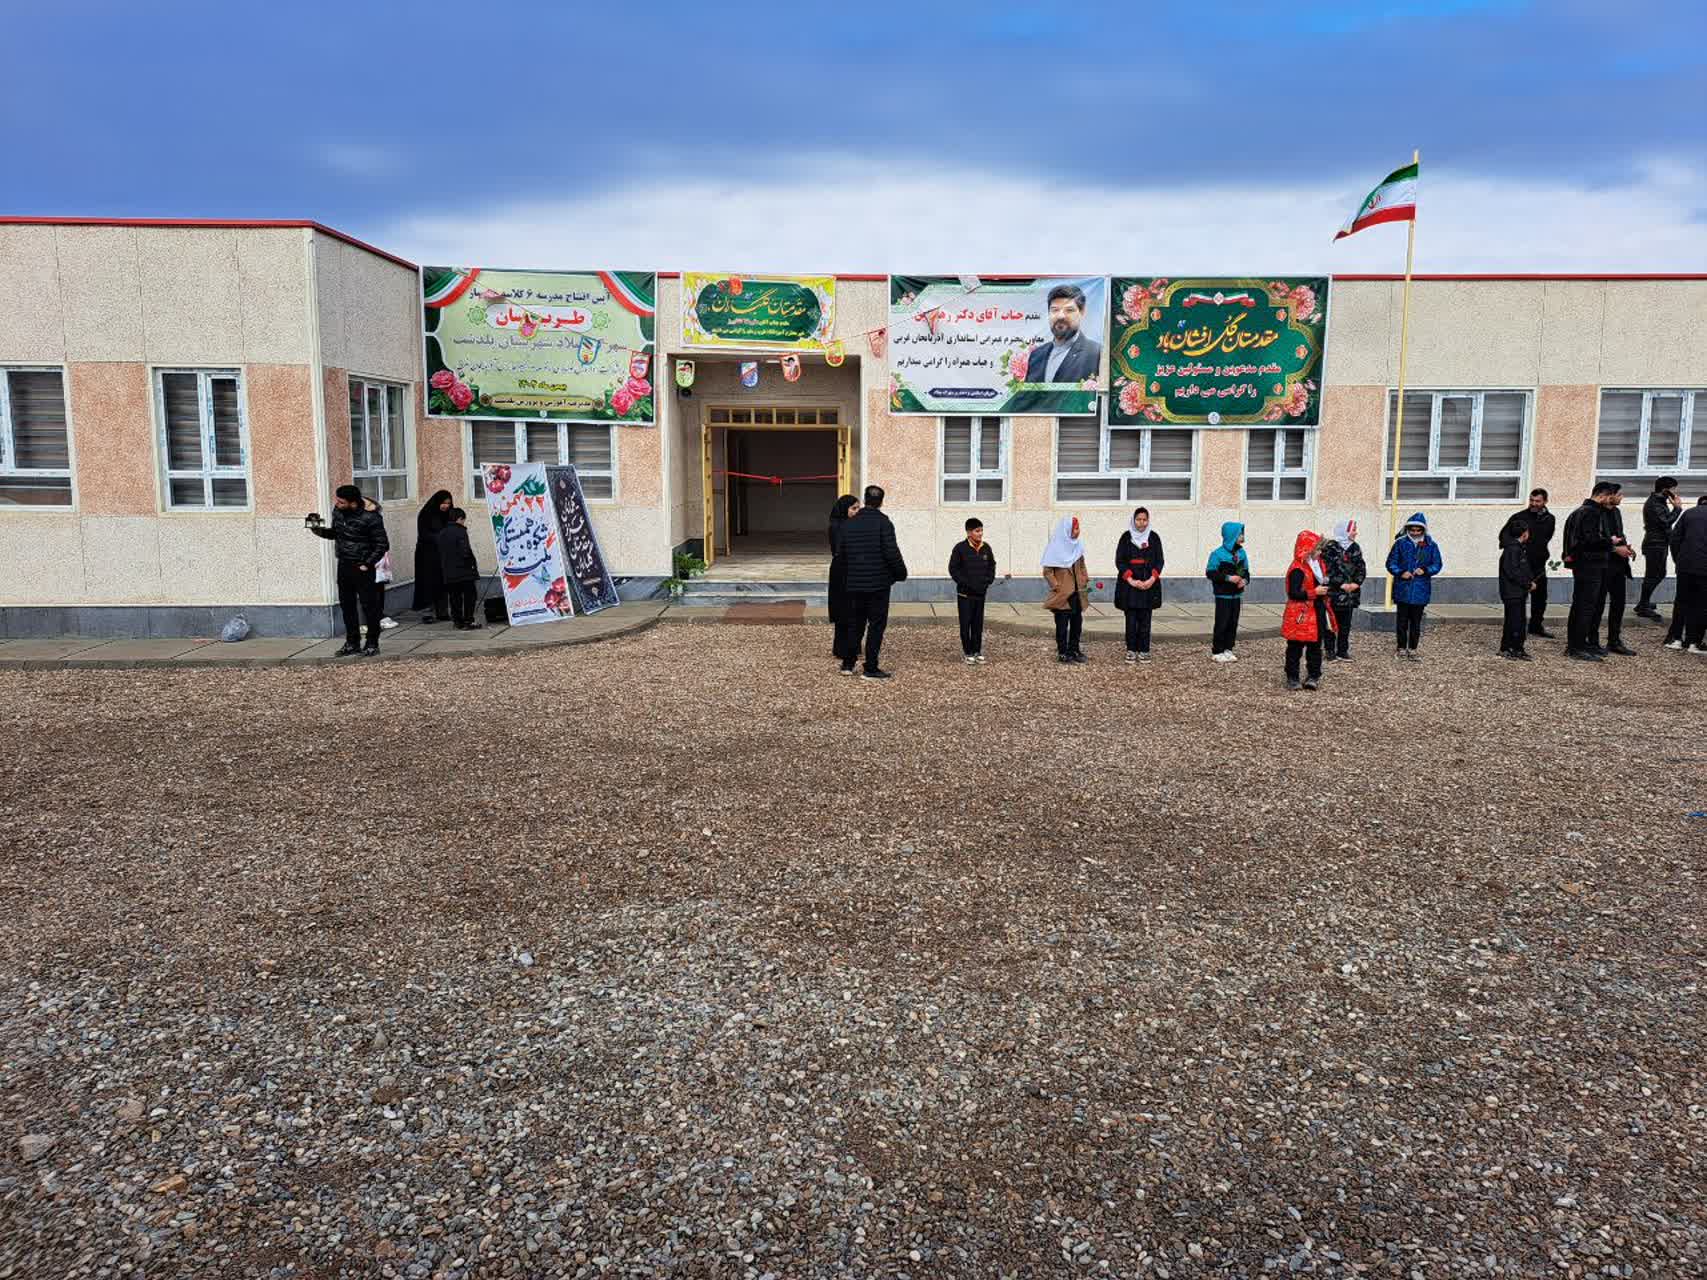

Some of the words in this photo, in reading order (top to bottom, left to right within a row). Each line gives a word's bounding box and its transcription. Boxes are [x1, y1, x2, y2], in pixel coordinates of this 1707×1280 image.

[536, 292, 563, 302] مدرسه
[955, 308, 975, 324] دکتر
[976, 307, 998, 324] آقای
[1001, 309, 1024, 321] جناب
[1169, 325, 1213, 351] افشان
[1222, 329, 1279, 353] مقدمتان
[923, 356, 944, 369] گرامی
[1222, 363, 1258, 377] مدعوین
[1259, 361, 1282, 377] مقدم
[1214, 365, 1221, 377] و
[1217, 383, 1247, 399] گرامی
[1247, 383, 1257, 398] را
